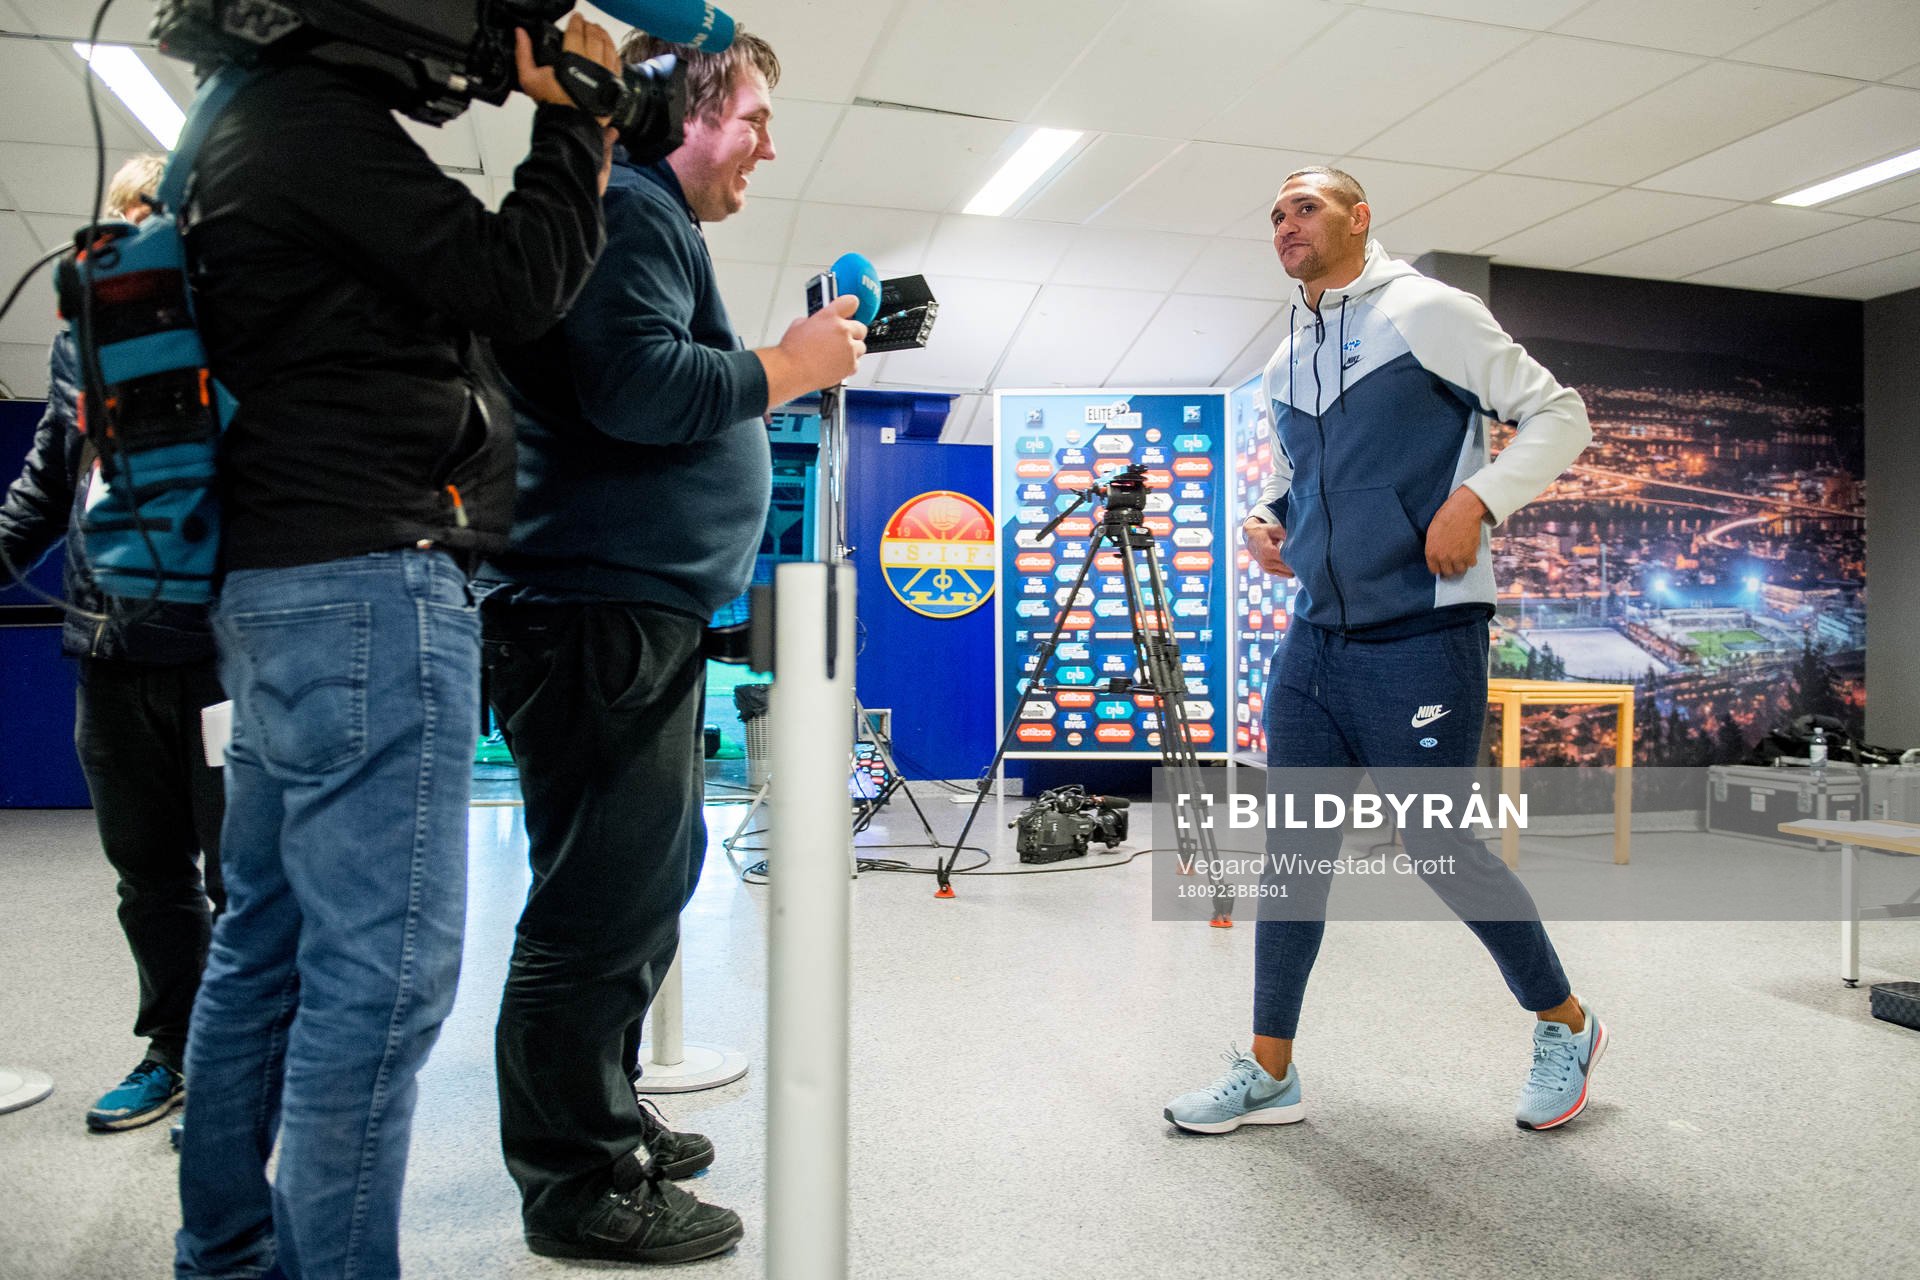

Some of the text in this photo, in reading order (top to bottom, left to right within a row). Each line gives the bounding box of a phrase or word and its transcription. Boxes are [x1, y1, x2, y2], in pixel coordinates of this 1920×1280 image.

[1088, 408, 1112, 420] ELITE
[1417, 704, 1443, 719] NIKE
[1020, 727, 1052, 736] altibox
[1099, 727, 1131, 736] altibox
